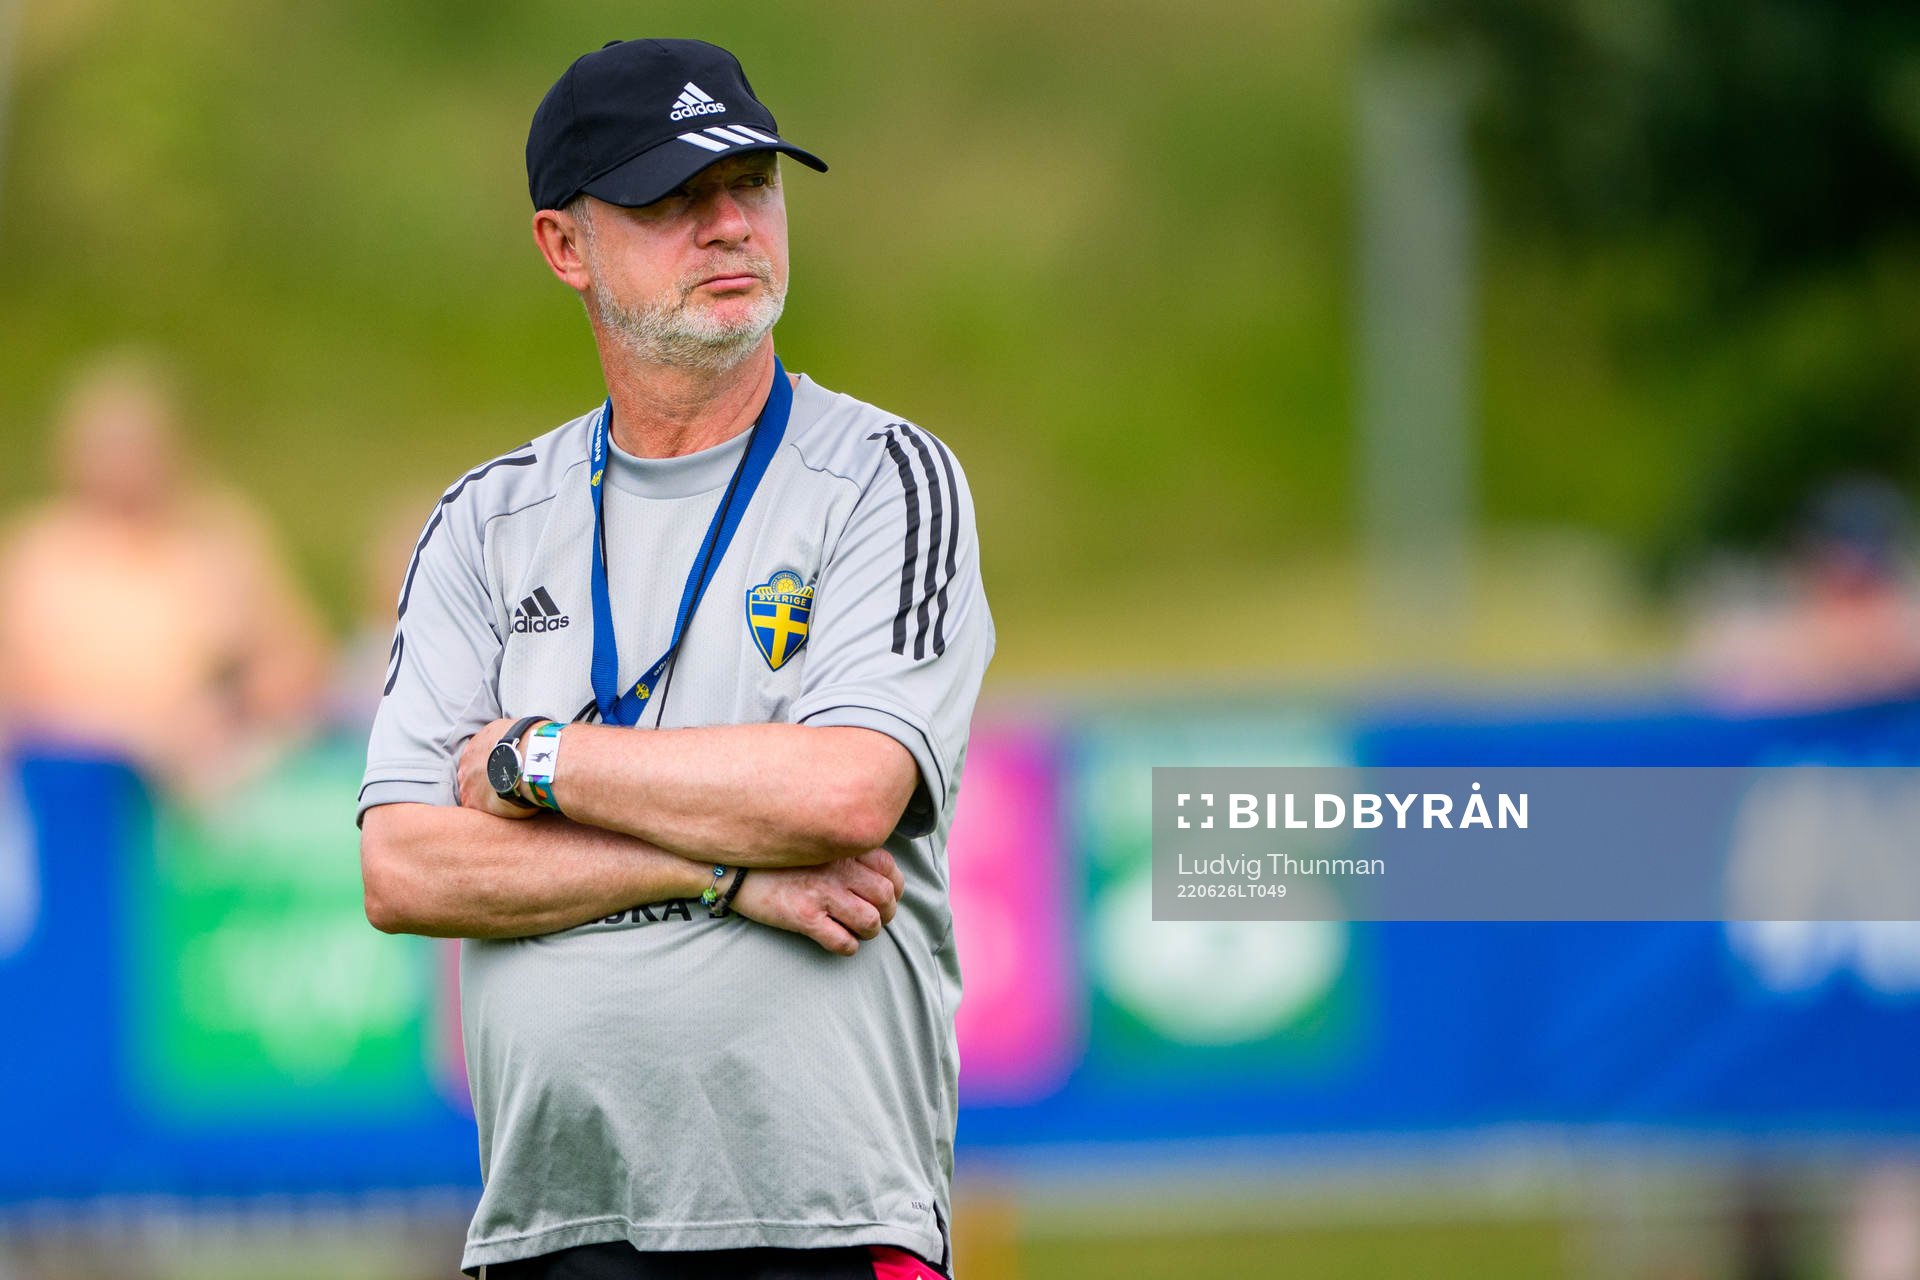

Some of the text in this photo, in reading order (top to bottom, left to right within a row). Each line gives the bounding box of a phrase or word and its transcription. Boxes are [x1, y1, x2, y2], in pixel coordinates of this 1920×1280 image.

[670, 101, 726, 121] adidas
[759, 593, 807, 606] SVERIGE
[510, 615, 570, 634] didas
